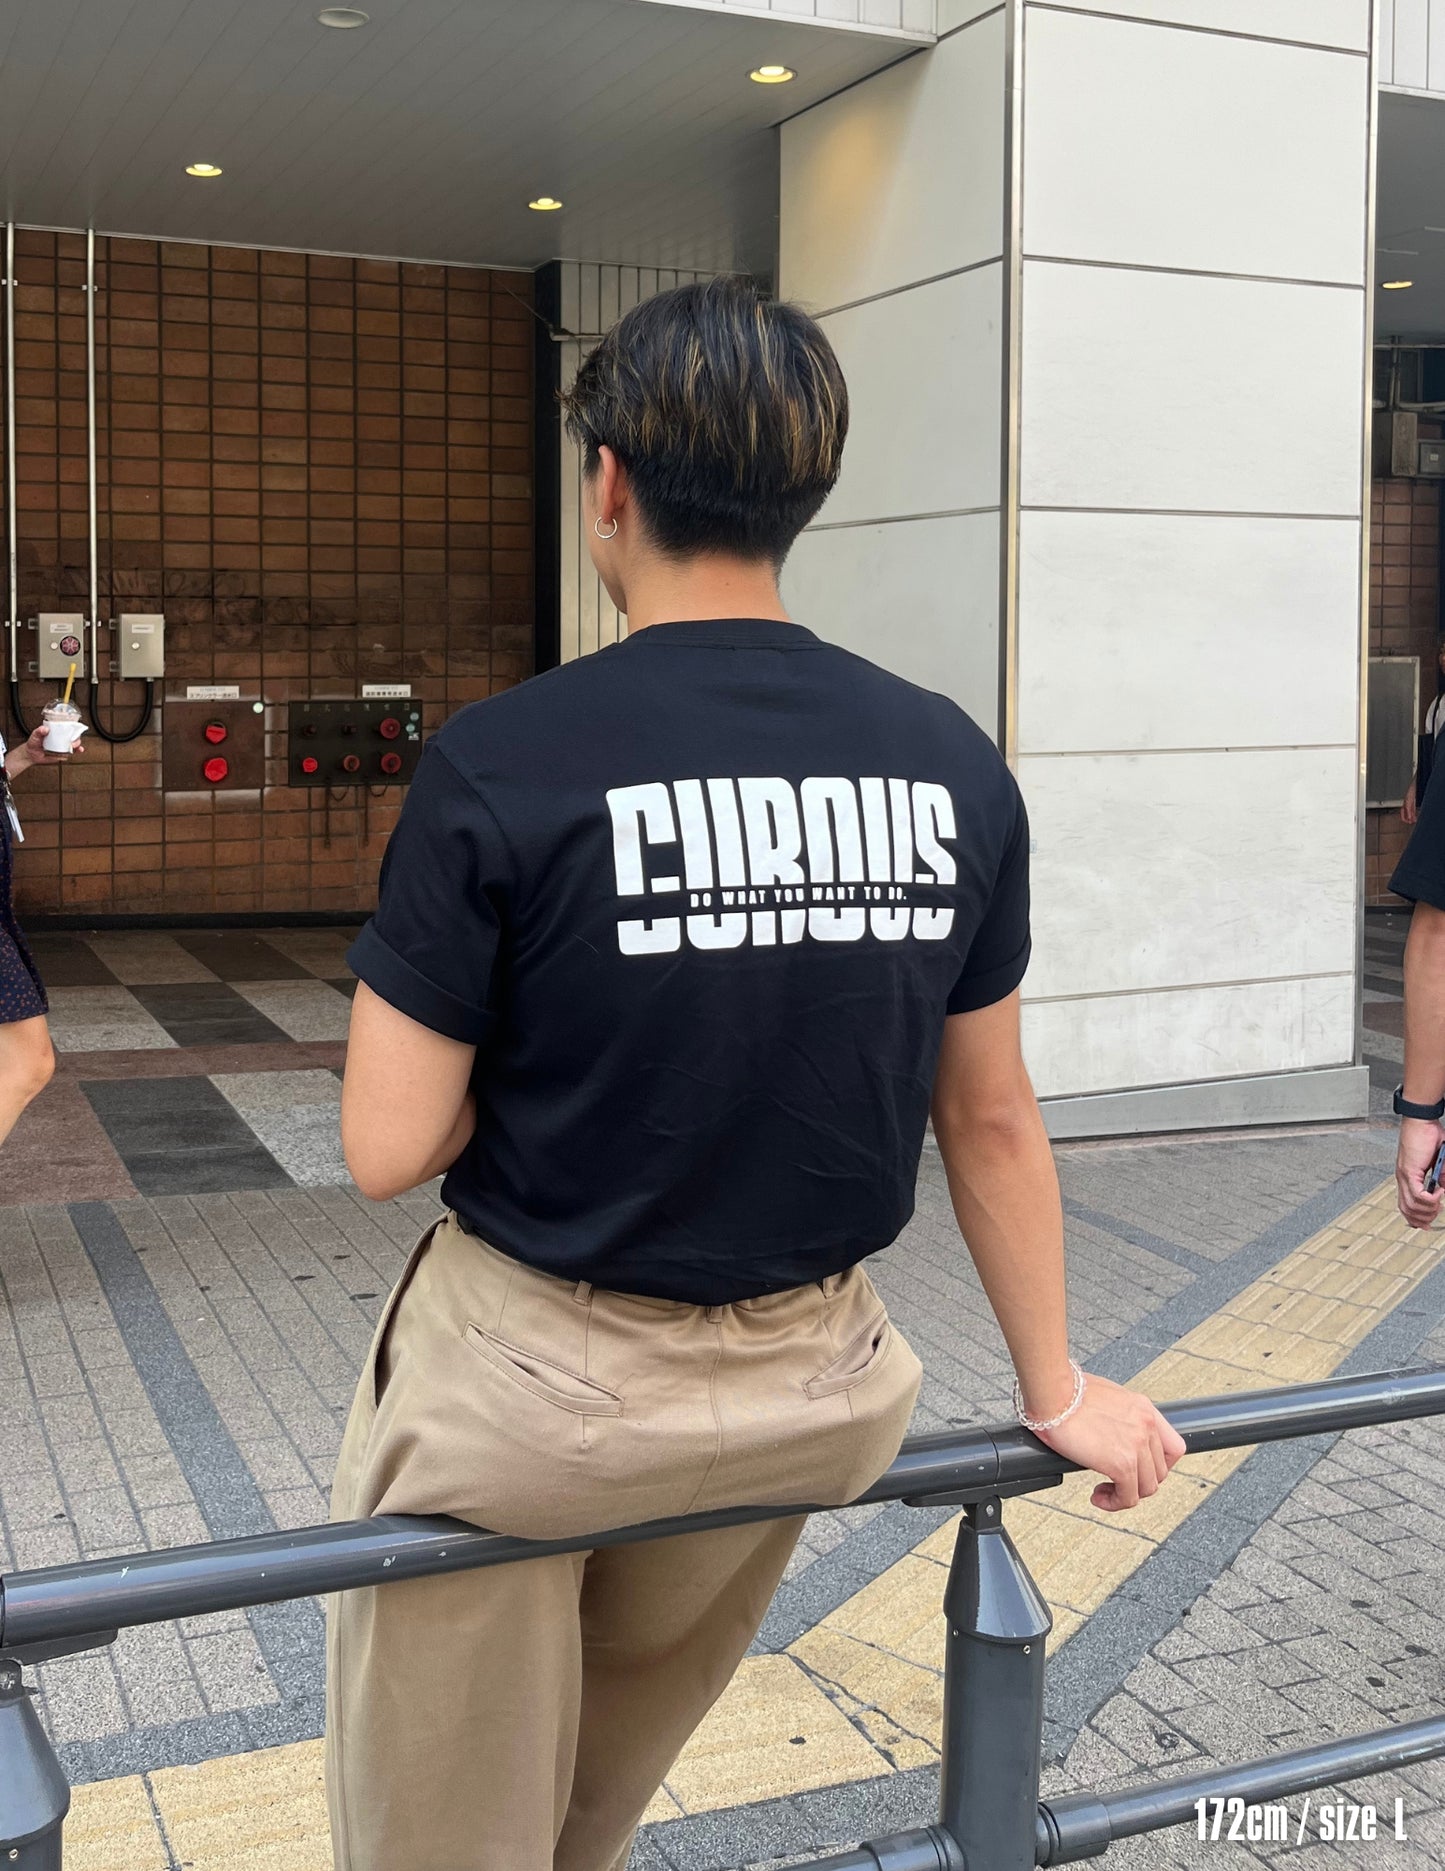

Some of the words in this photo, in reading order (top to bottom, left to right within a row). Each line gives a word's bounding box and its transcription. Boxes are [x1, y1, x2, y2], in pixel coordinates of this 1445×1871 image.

[690, 892, 712, 908] DO
[721, 889, 766, 906] WHAT
[774, 888, 805, 903] YOU
[812, 886, 856, 901] WANT
[863, 886, 881, 900] TO
